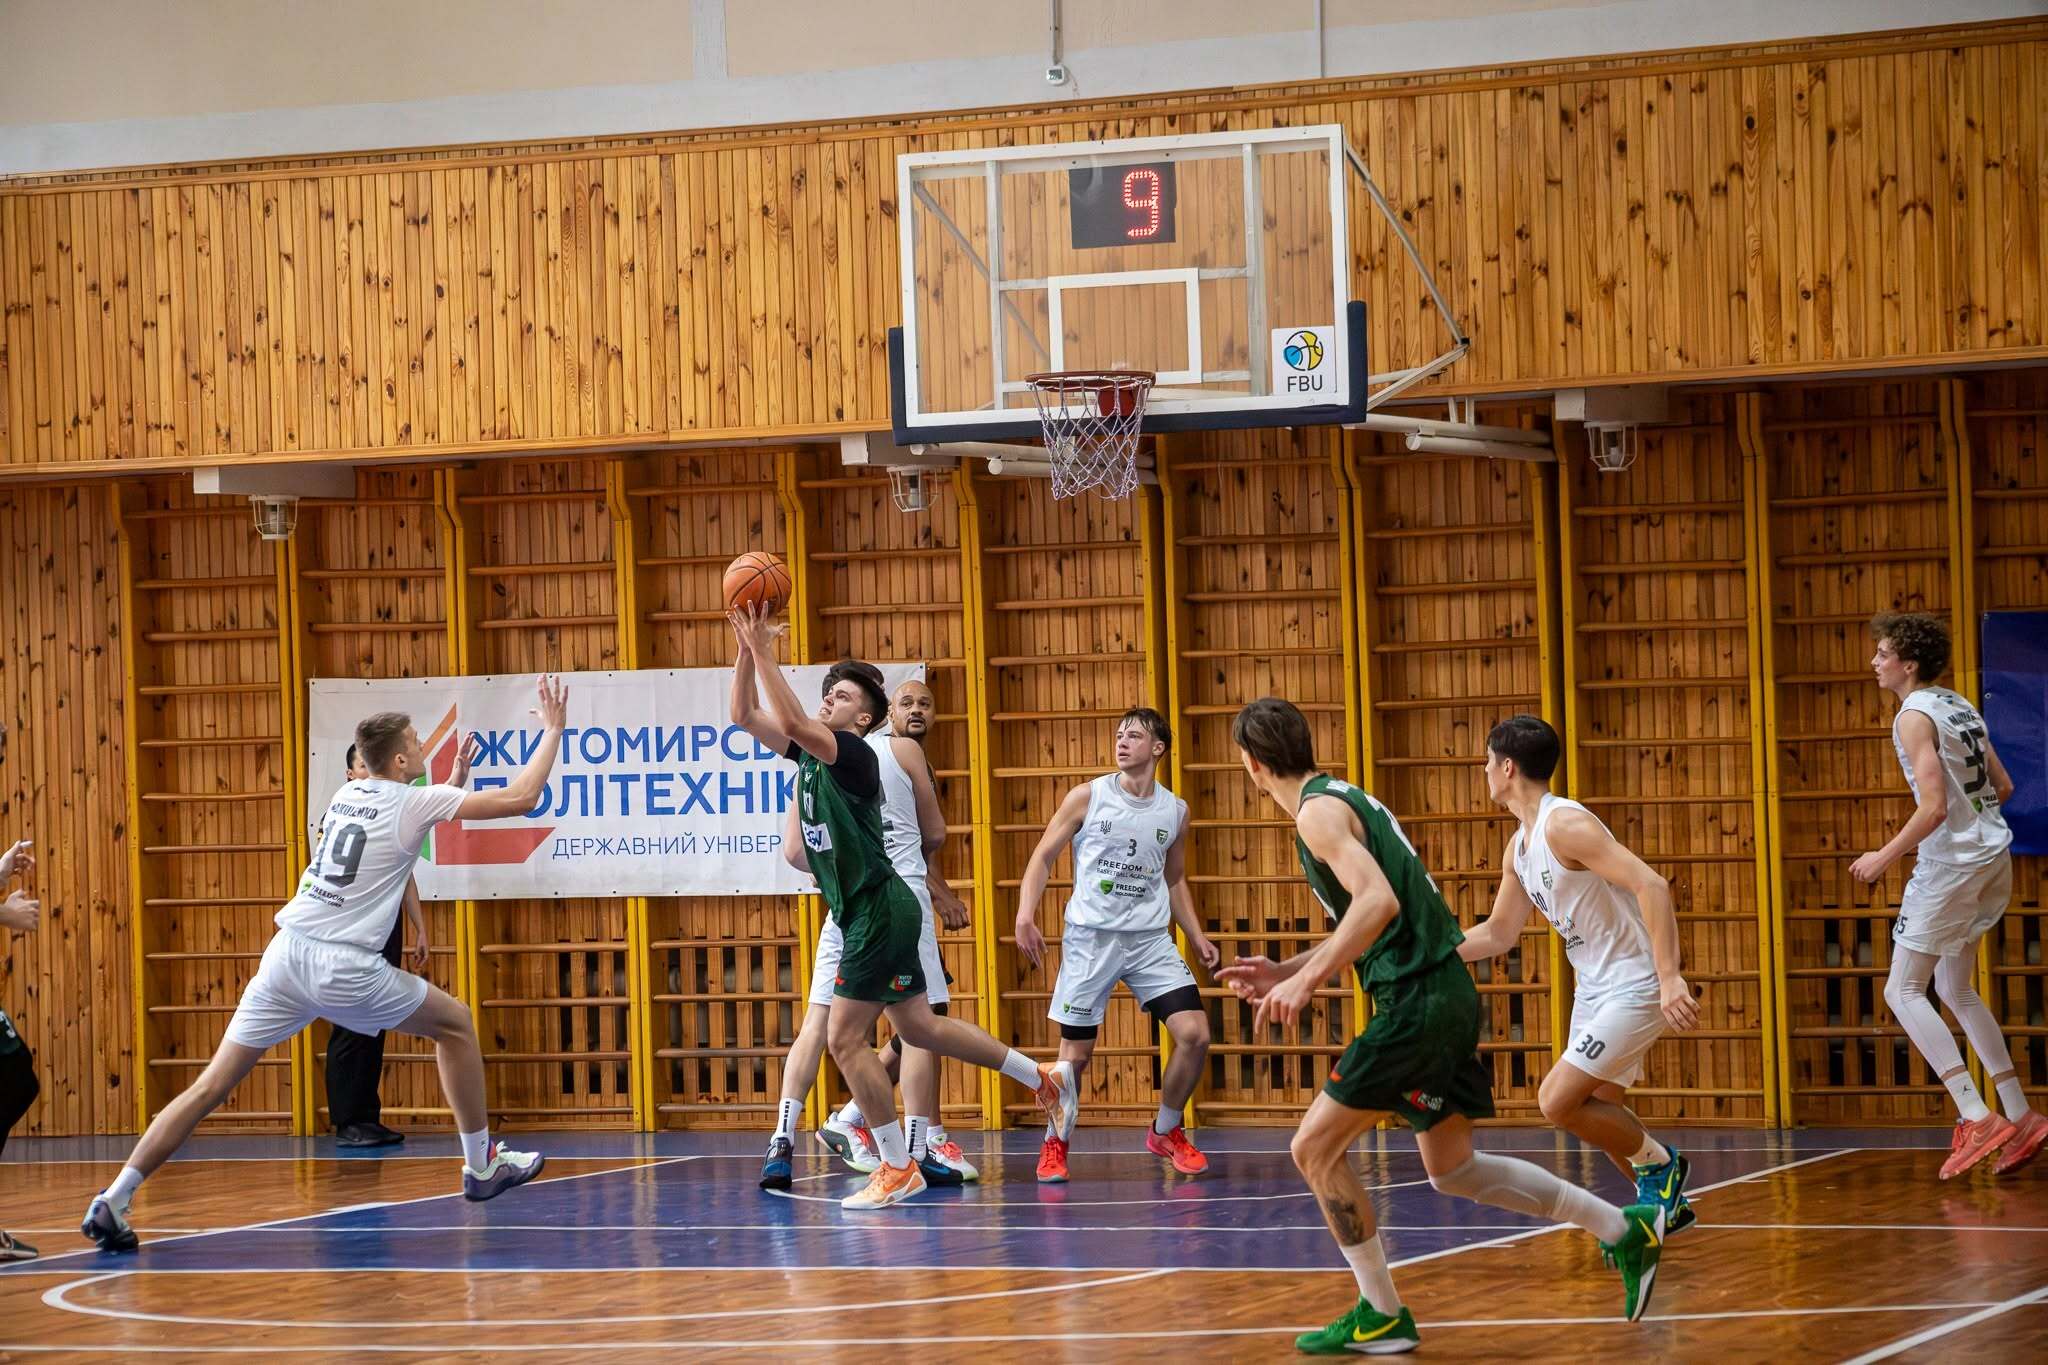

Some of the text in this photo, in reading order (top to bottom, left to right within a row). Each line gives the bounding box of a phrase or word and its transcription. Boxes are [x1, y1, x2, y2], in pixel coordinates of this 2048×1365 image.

[1124, 170, 1160, 237] 9
[1287, 374, 1323, 392] FBU
[308, 819, 368, 888] 19
[552, 832, 696, 860] ДЕРЖАВНИЙ
[703, 834, 782, 854] УНІВЕР
[1127, 838, 1138, 857] 3
[1098, 859, 1142, 872] FREEDOM
[1115, 883, 1146, 893] FREEDOM
[1575, 1034, 1606, 1060] 30
